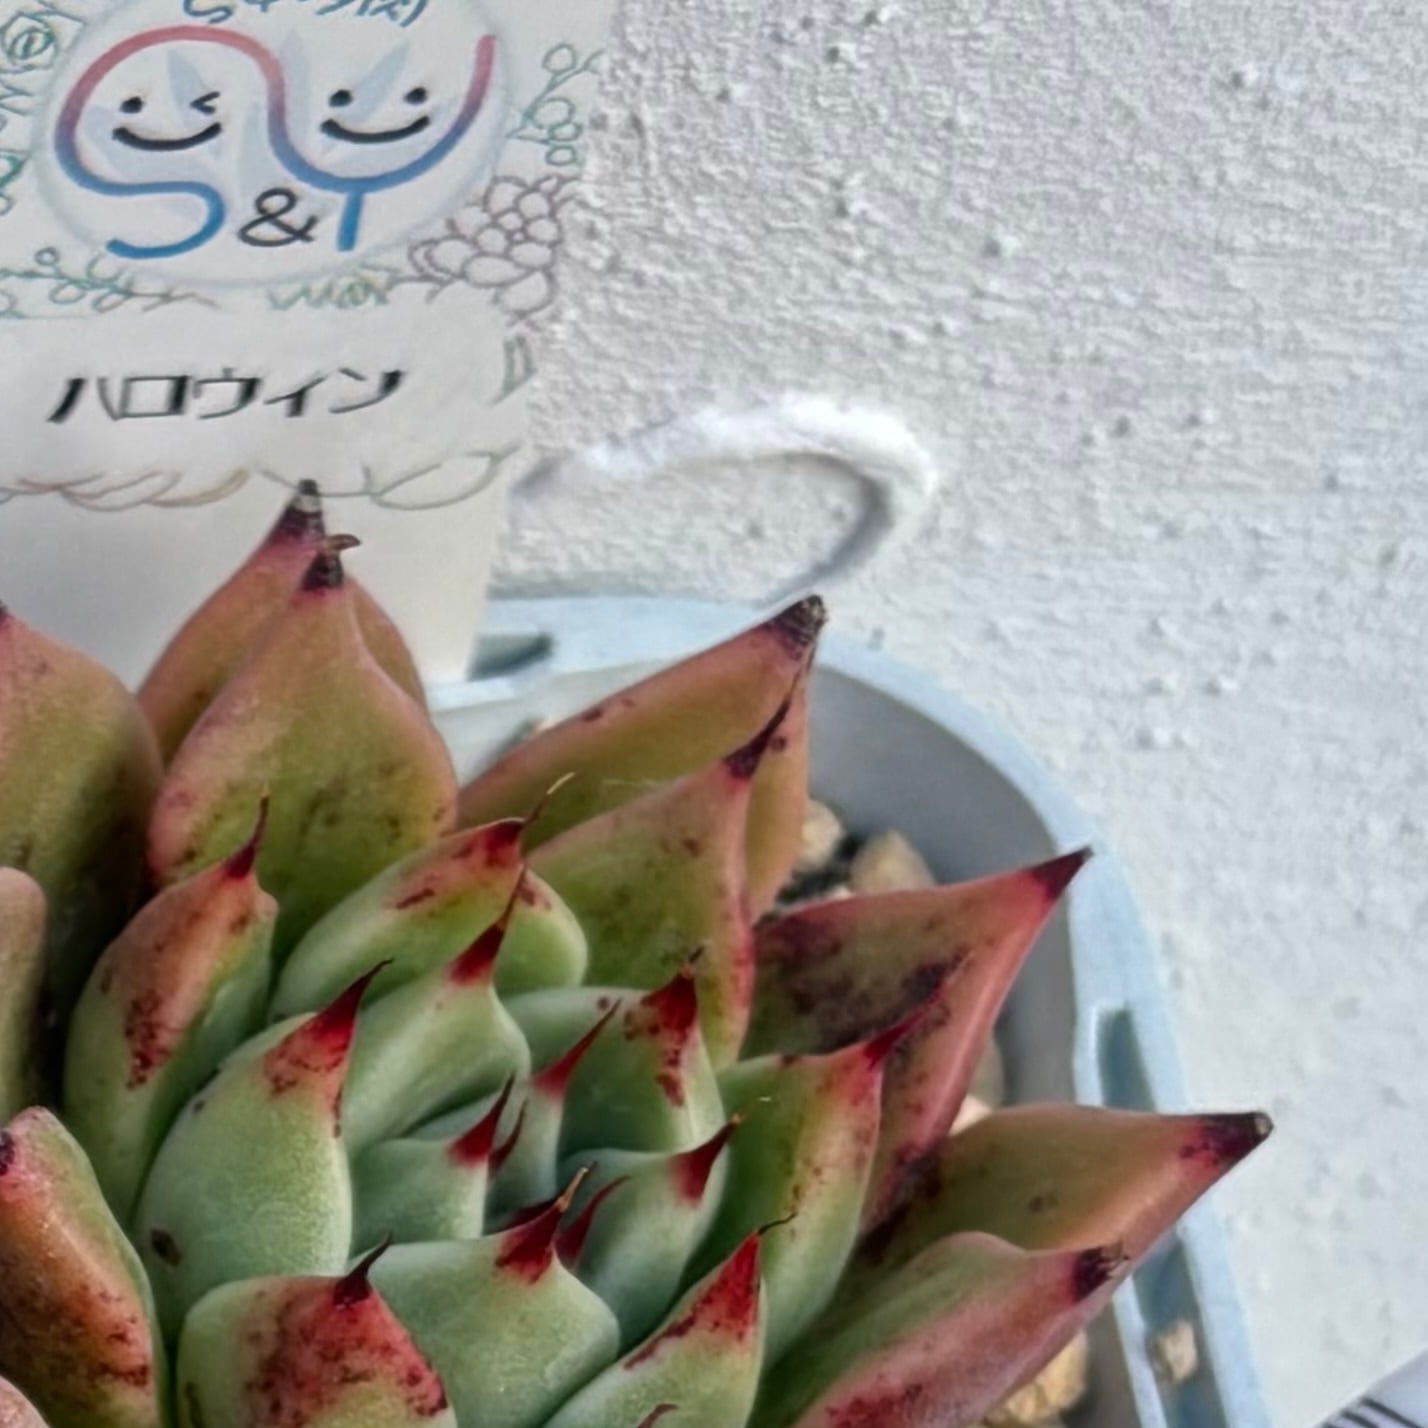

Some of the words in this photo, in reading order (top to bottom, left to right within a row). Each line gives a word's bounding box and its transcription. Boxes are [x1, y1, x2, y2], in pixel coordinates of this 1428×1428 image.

[46, 366, 406, 423] ハロウィン
